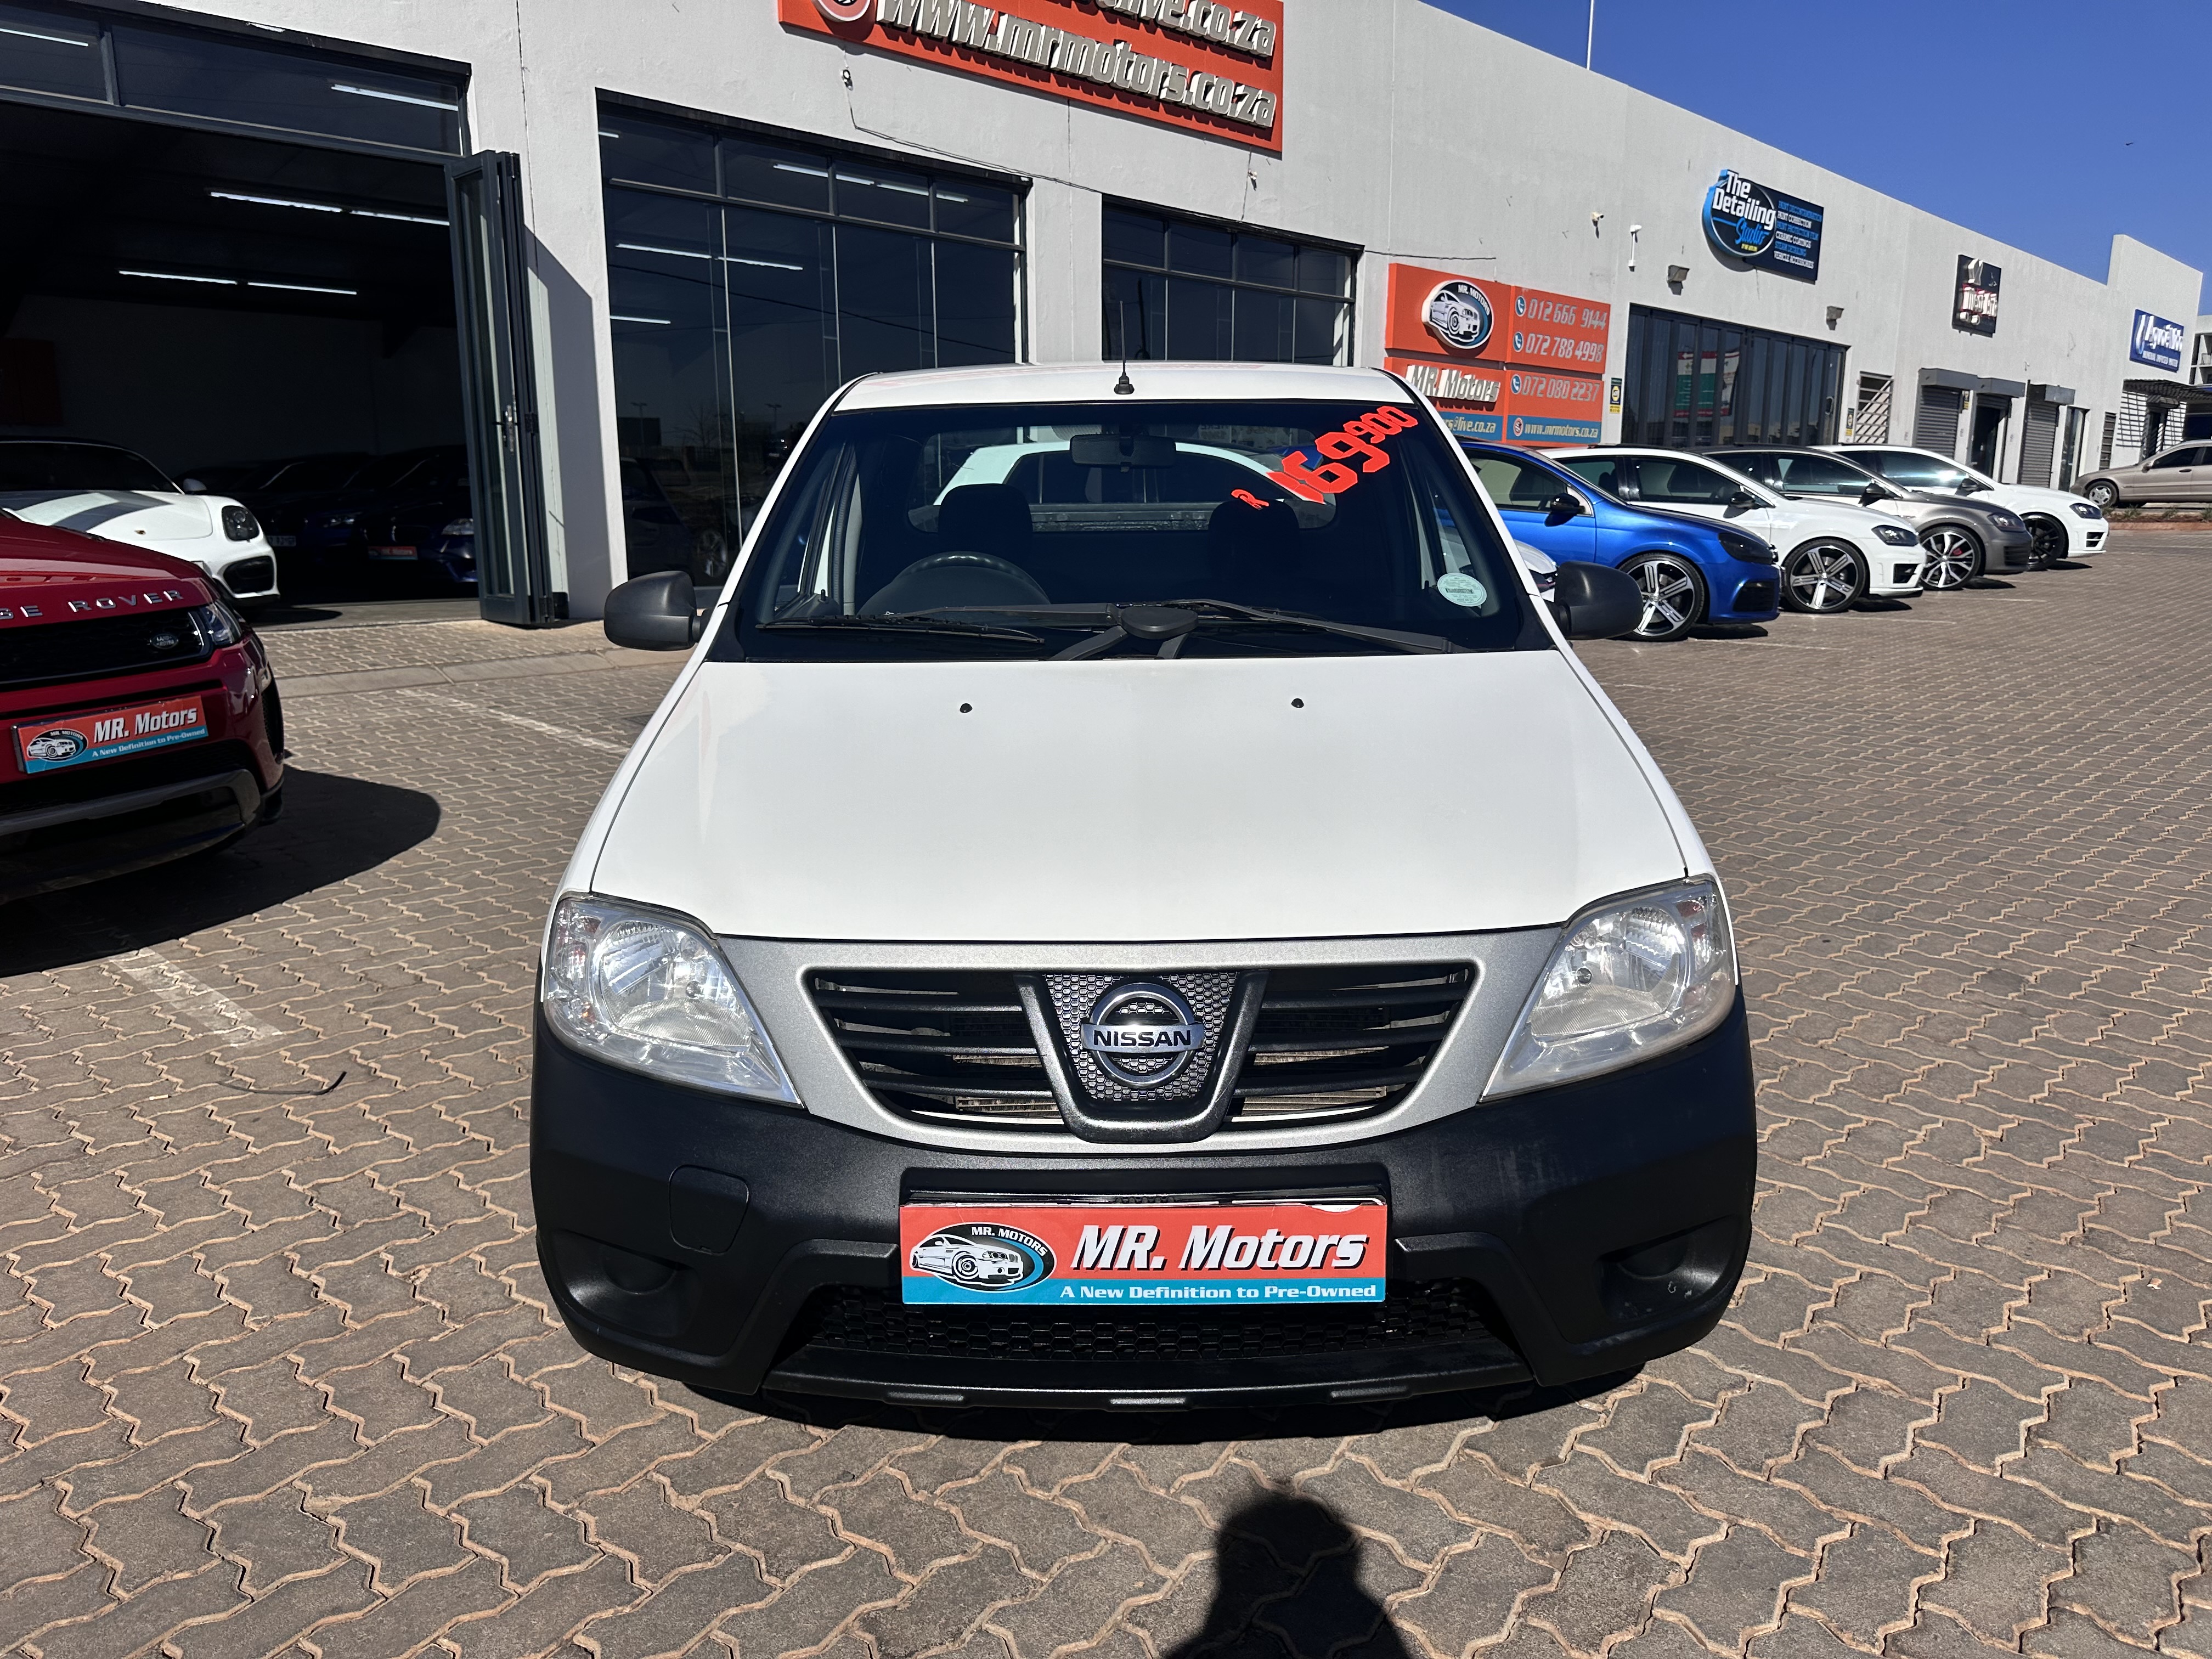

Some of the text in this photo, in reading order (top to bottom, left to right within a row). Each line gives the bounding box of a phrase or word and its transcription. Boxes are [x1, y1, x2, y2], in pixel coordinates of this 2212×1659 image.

[1726, 171, 1751, 199] The
[1712, 188, 1776, 230] Detailing
[1470, 287, 1490, 315] MOTORS
[1527, 298, 1607, 330] 012 666 9144
[1525, 333, 1604, 362] 072 788 4998
[1406, 365, 1500, 402] MR. Motors
[1521, 375, 1546, 397] 072
[1547, 378, 1570, 399] 080
[1571, 381, 1600, 402] 2237
[1525, 424, 1598, 438] www.mrmotors.co.za
[68, 590, 184, 612] ROVER
[61, 731, 84, 740] MOTORS
[93, 708, 197, 743] MR. Motors
[100, 747, 117, 756] New
[119, 740, 156, 752] Definition
[166, 728, 205, 742] Pre-Owned
[1093, 1030, 1191, 1047] NISSAN
[972, 1226, 1048, 1257] MR. MOTORS
[1070, 1224, 1368, 1270] MR. Motors
[1060, 1285, 1376, 1299] A New Definition to Pre-Owned
